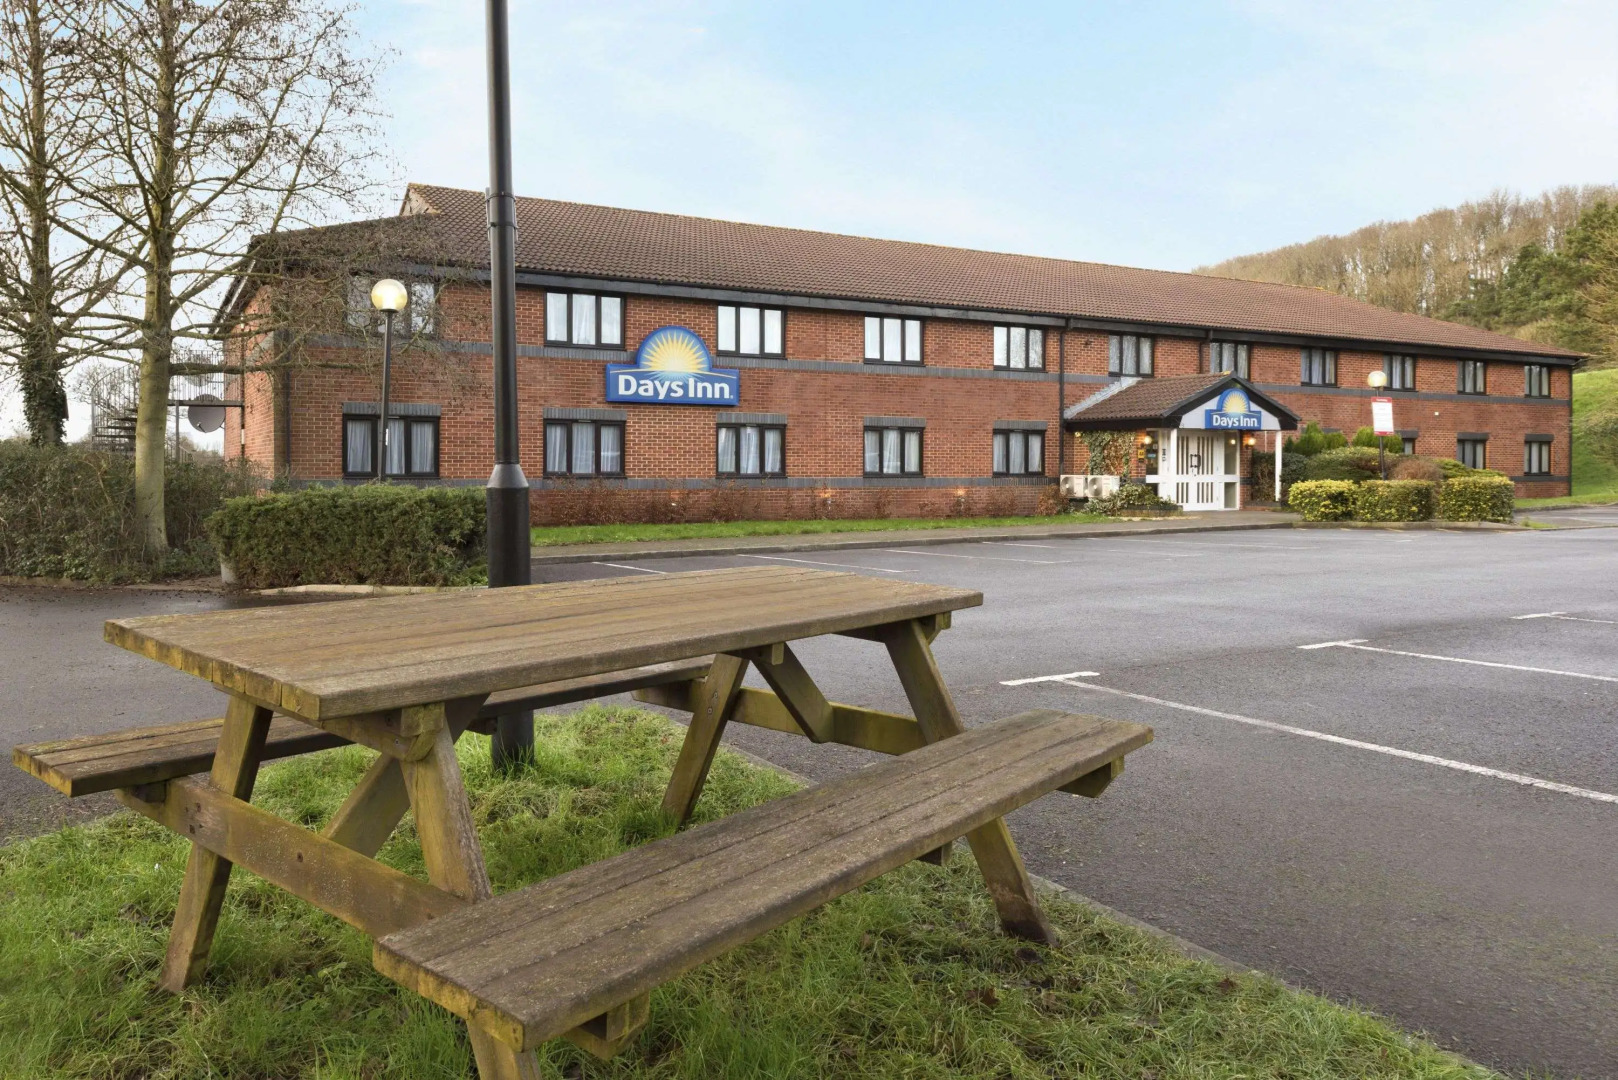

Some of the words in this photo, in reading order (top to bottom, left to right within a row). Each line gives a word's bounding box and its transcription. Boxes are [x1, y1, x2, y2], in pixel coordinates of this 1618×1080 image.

[618, 374, 684, 400] Days
[688, 377, 730, 399] Inn
[1212, 414, 1239, 428] Days
[1240, 415, 1258, 427] Inn
